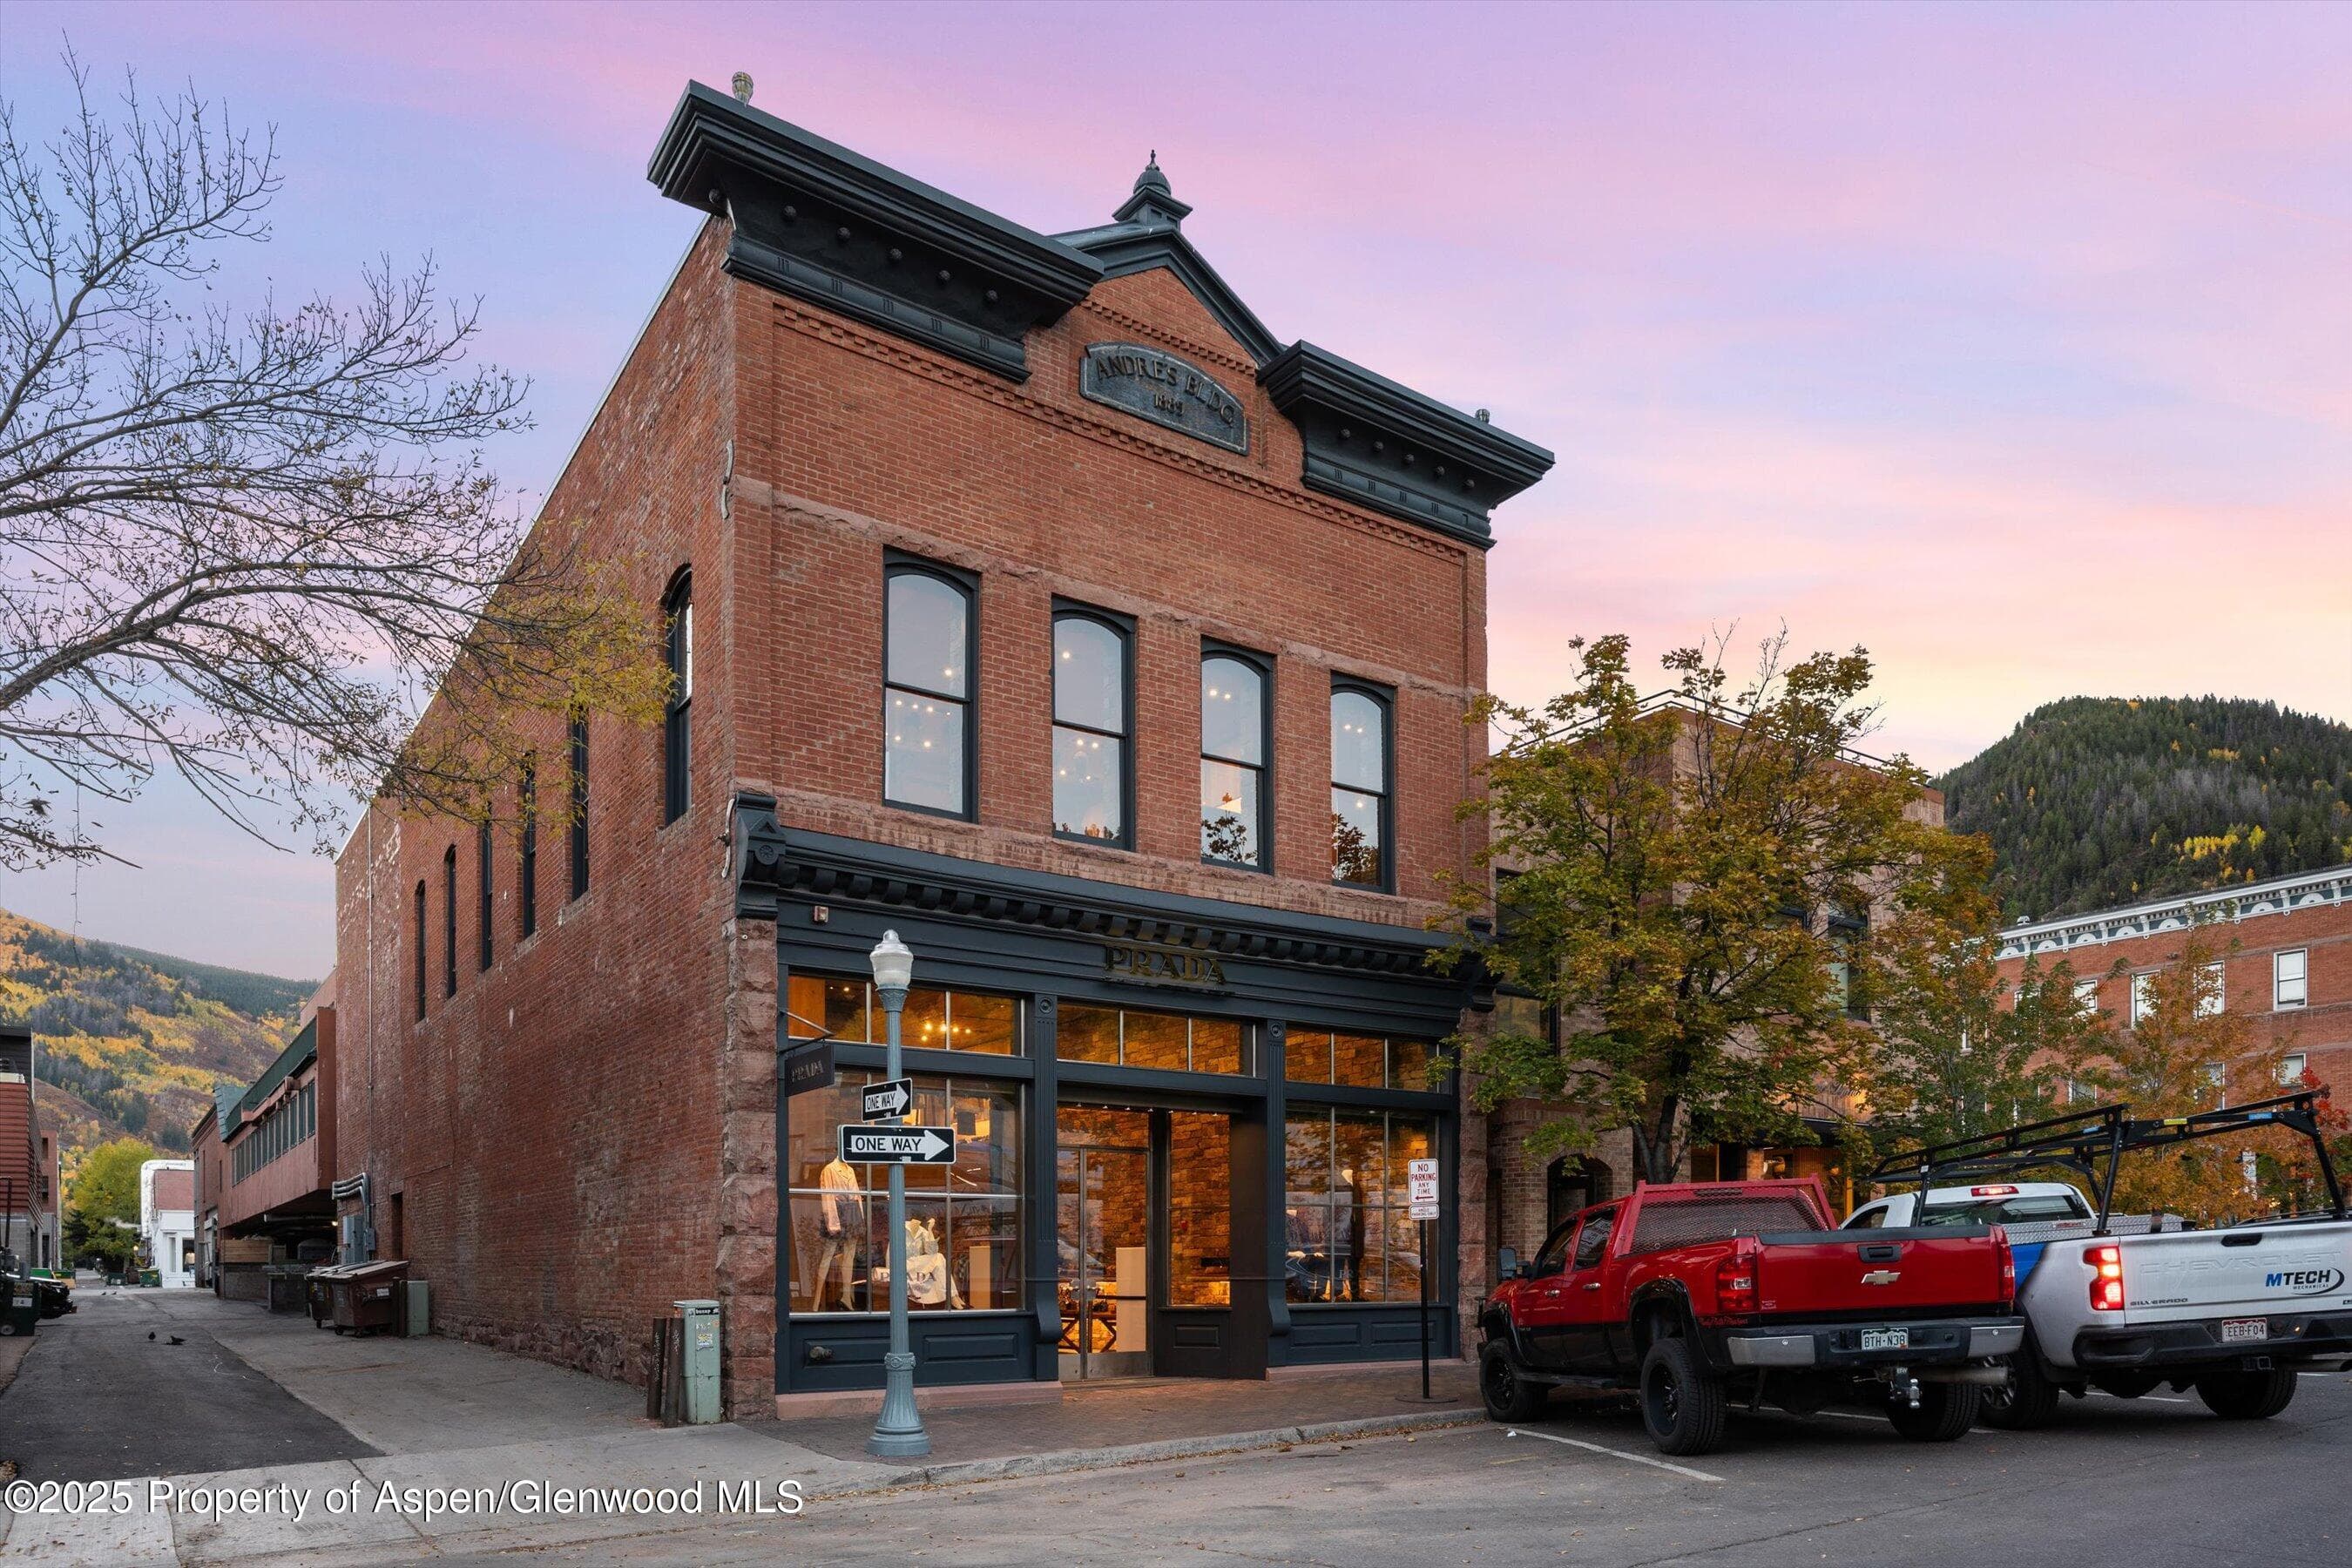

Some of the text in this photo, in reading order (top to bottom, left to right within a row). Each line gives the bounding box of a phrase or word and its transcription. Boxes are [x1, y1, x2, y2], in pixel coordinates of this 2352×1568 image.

[1185, 375, 1235, 427] BLDG
[1104, 944, 1227, 985] PRADA
[791, 1059, 824, 1083] PRADA
[867, 1092, 896, 1110] ONE WAY
[855, 1137, 922, 1152] ONE WAY
[1411, 1173, 1436, 1182] PARKING
[880, 1272, 936, 1281] PADA
[2265, 1269, 2331, 1287] MTECH
